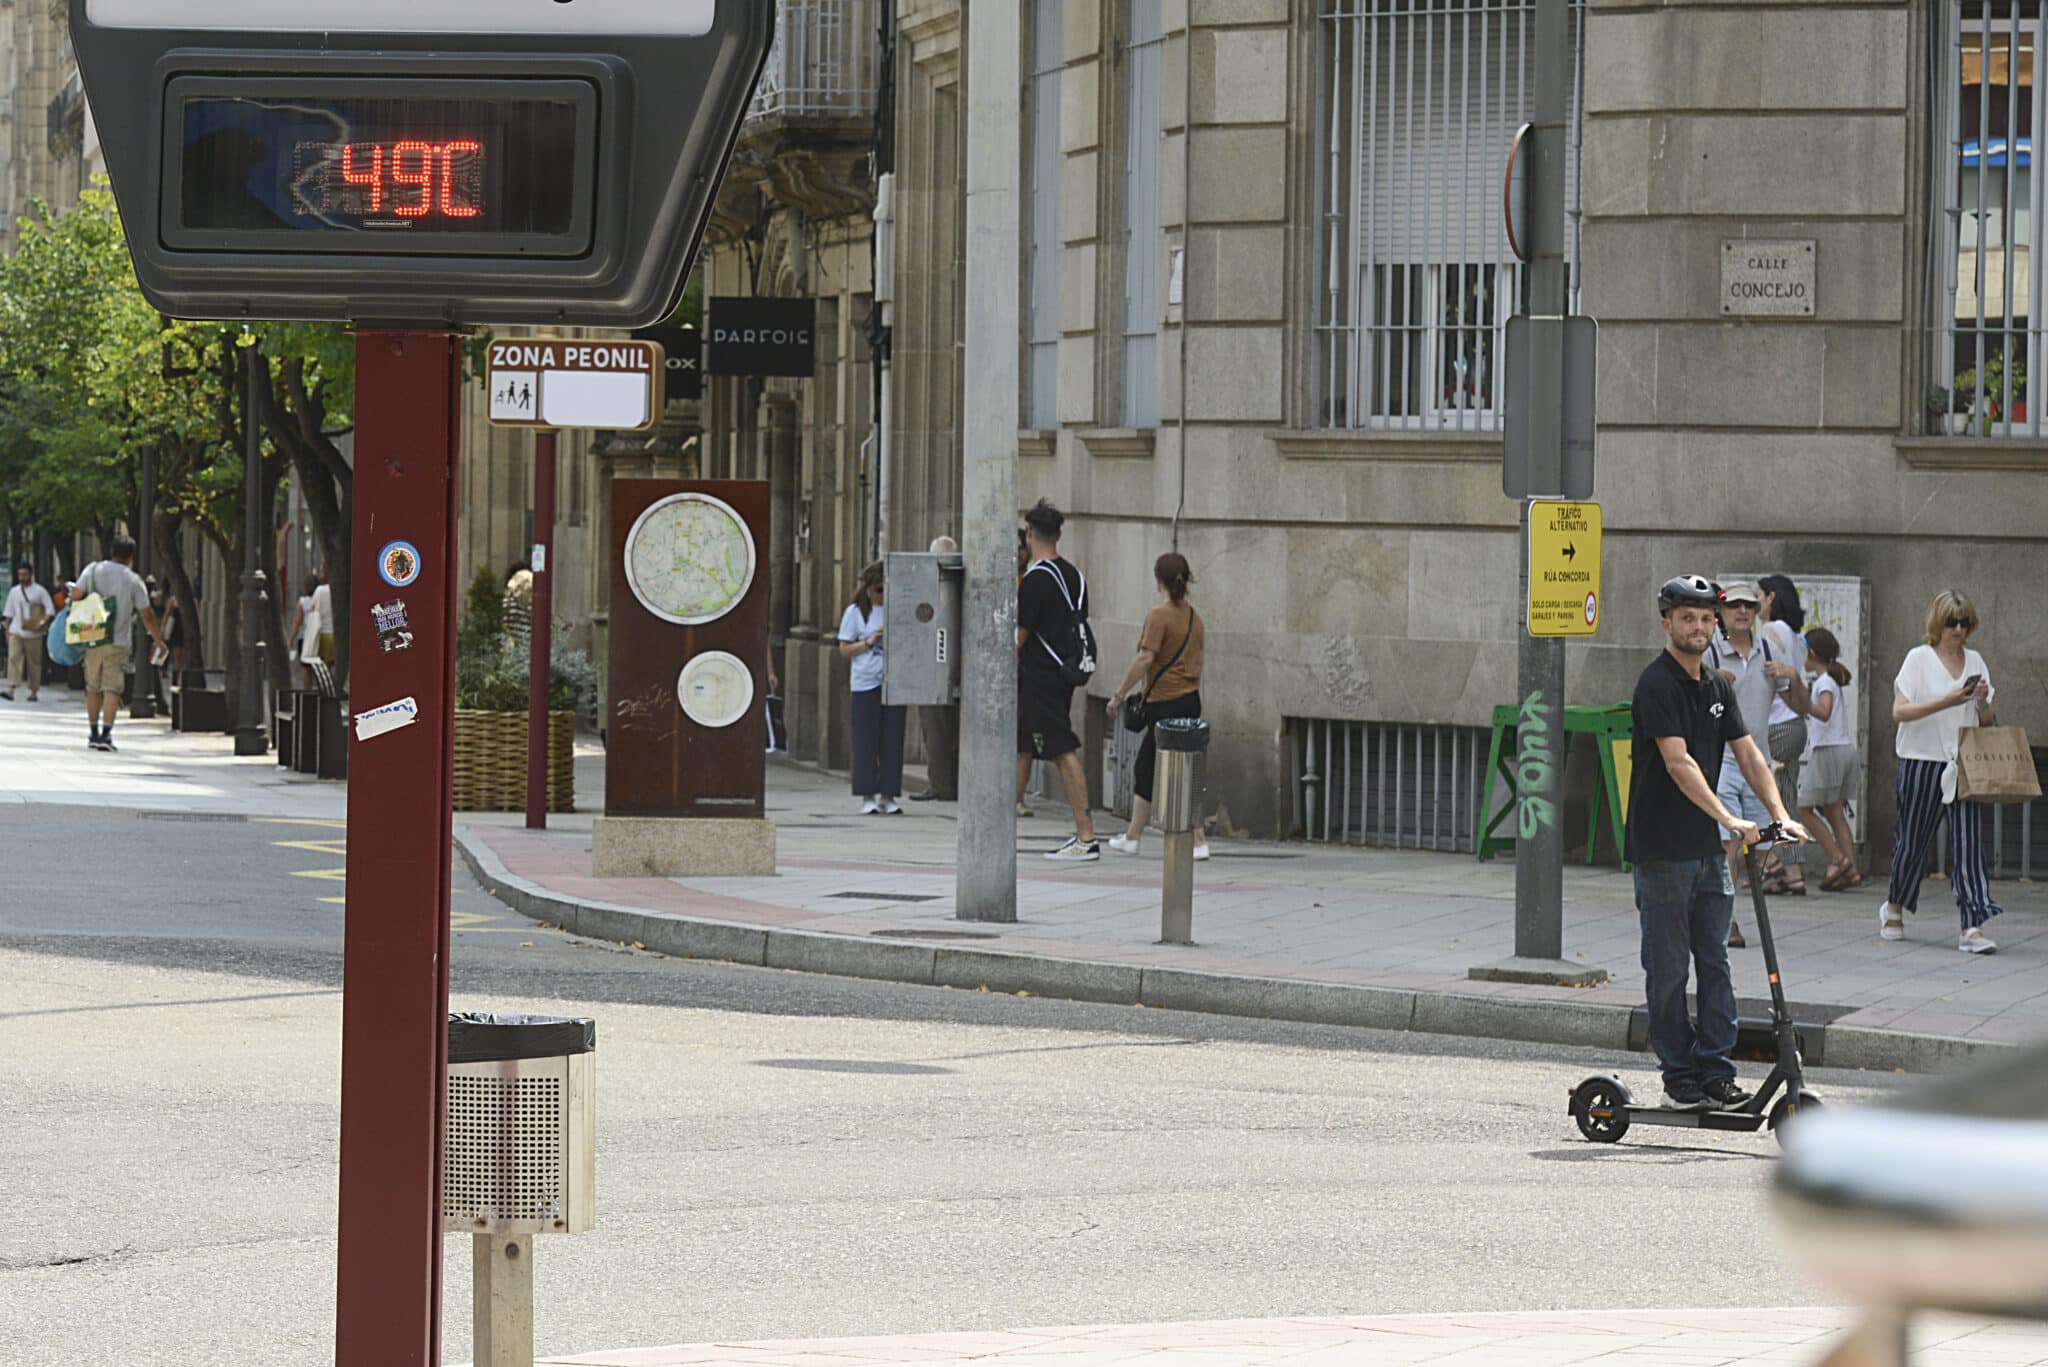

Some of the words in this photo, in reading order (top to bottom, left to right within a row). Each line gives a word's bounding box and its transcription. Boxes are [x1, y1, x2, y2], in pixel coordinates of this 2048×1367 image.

[1748, 258, 1789, 270] CALLE
[1731, 282, 1805, 298] CONCEJO
[492, 346, 556, 367] ZONA
[564, 347, 650, 369] PEONIL
[1549, 520, 1588, 532] ALTERNATIVO
[1558, 571, 1591, 582] CONCORDIA
